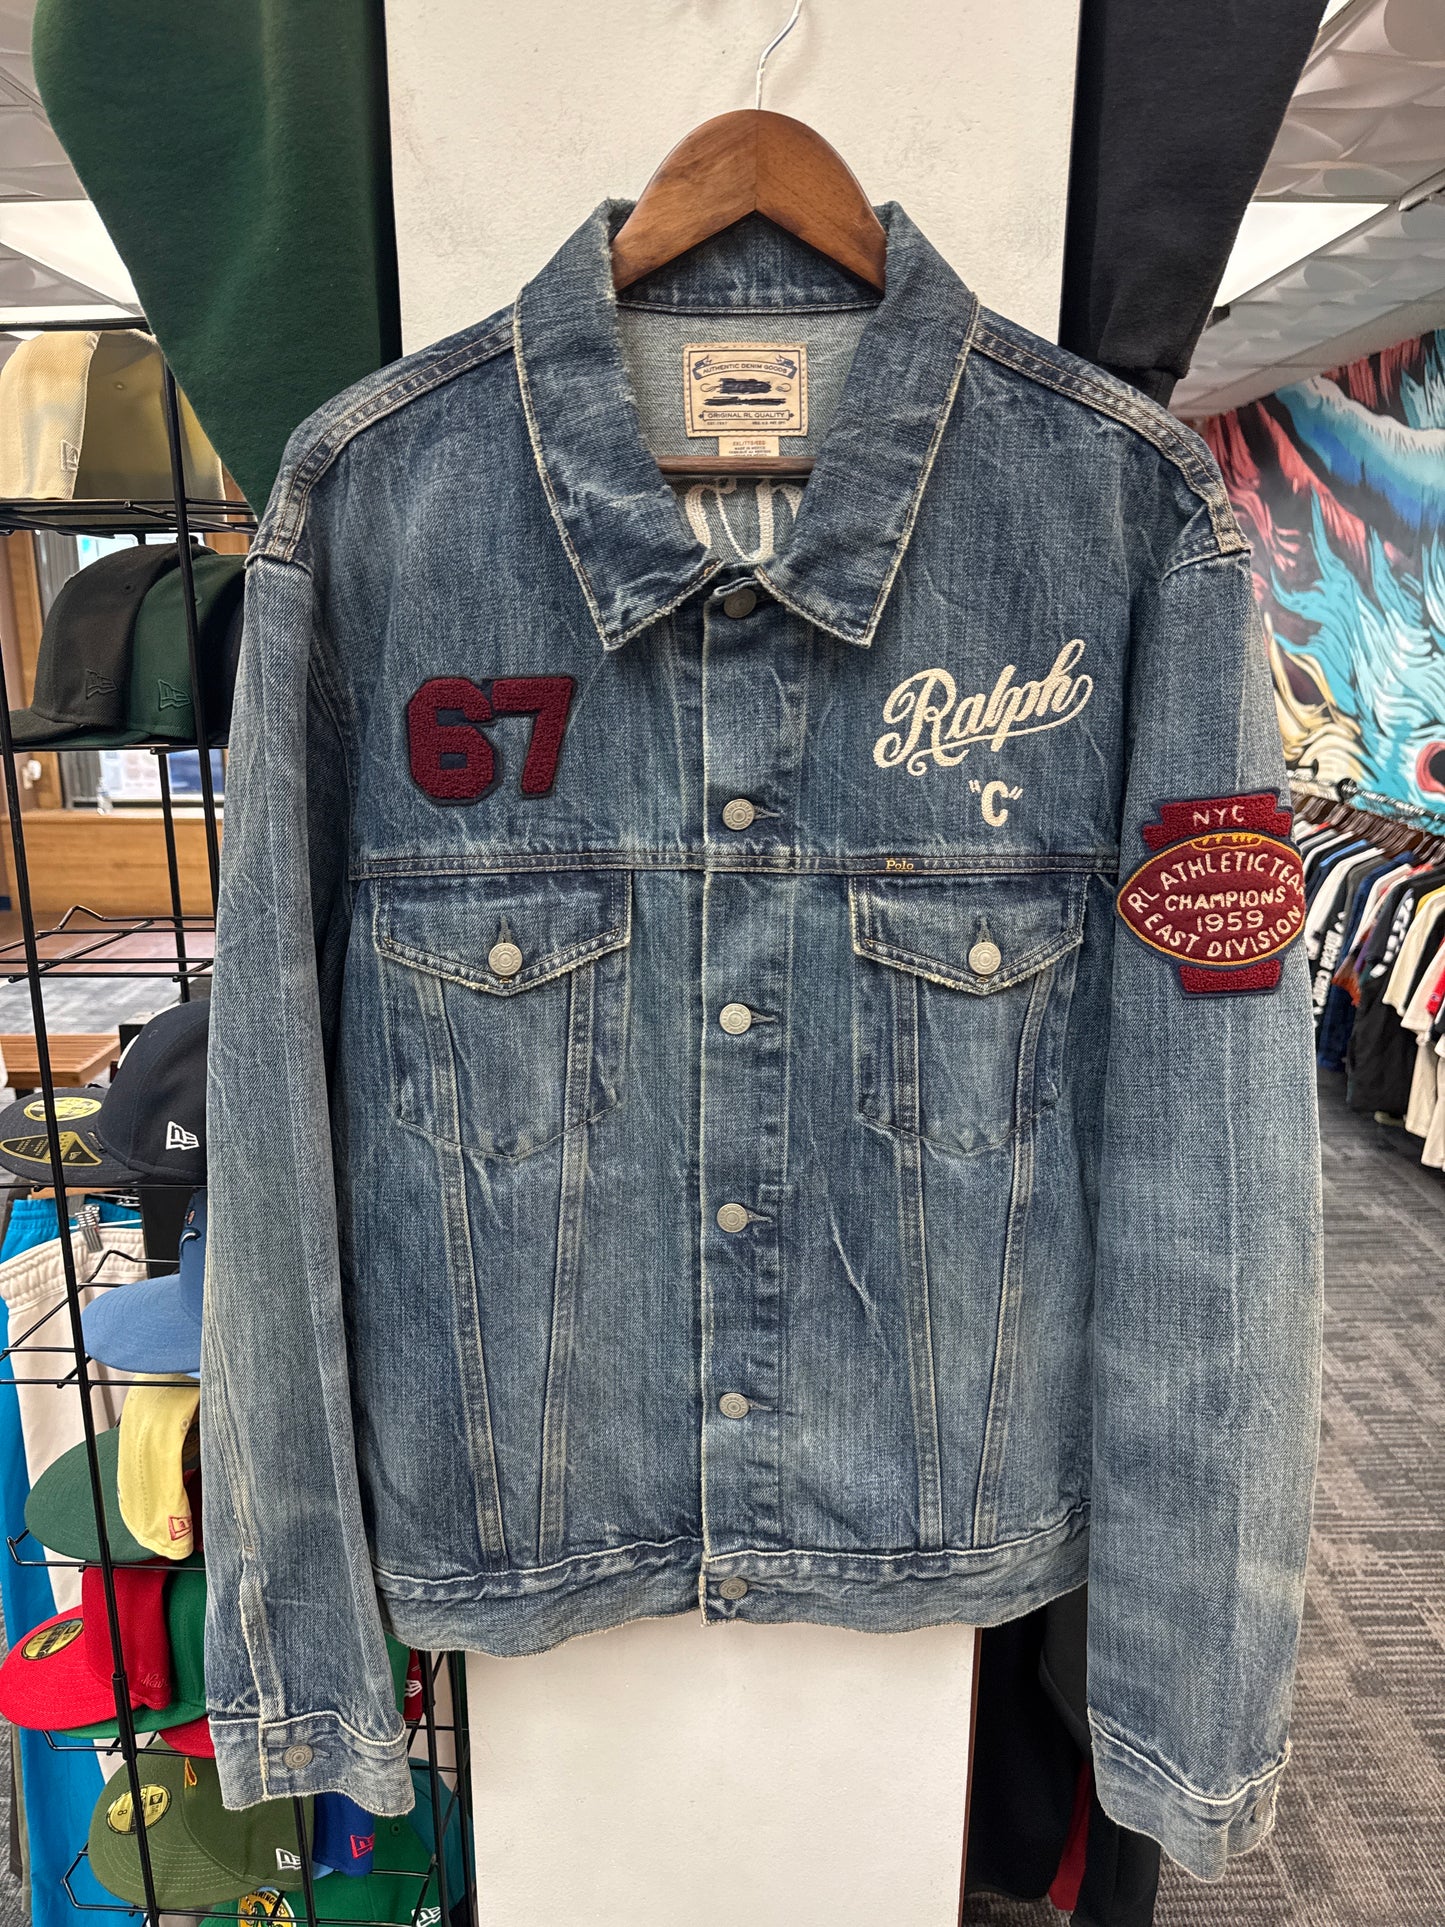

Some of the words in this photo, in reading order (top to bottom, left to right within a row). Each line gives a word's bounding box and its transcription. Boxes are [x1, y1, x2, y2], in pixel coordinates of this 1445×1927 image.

[702, 363, 740, 374] AUTHENTIC
[763, 363, 788, 374] GOODS
[872, 638, 1094, 777] Ralph
[406, 676, 575, 803] 67
[1192, 805, 1245, 827] NYC
[885, 859, 914, 871] Polo
[1127, 887, 1160, 914] RL
[1159, 851, 1269, 891] ATHLETIC
[1164, 885, 1287, 912] CHAMPIONS
[1144, 912, 1201, 953] EAST
[1206, 904, 1302, 959] DIVISION
[1196, 909, 1265, 933] 1959
